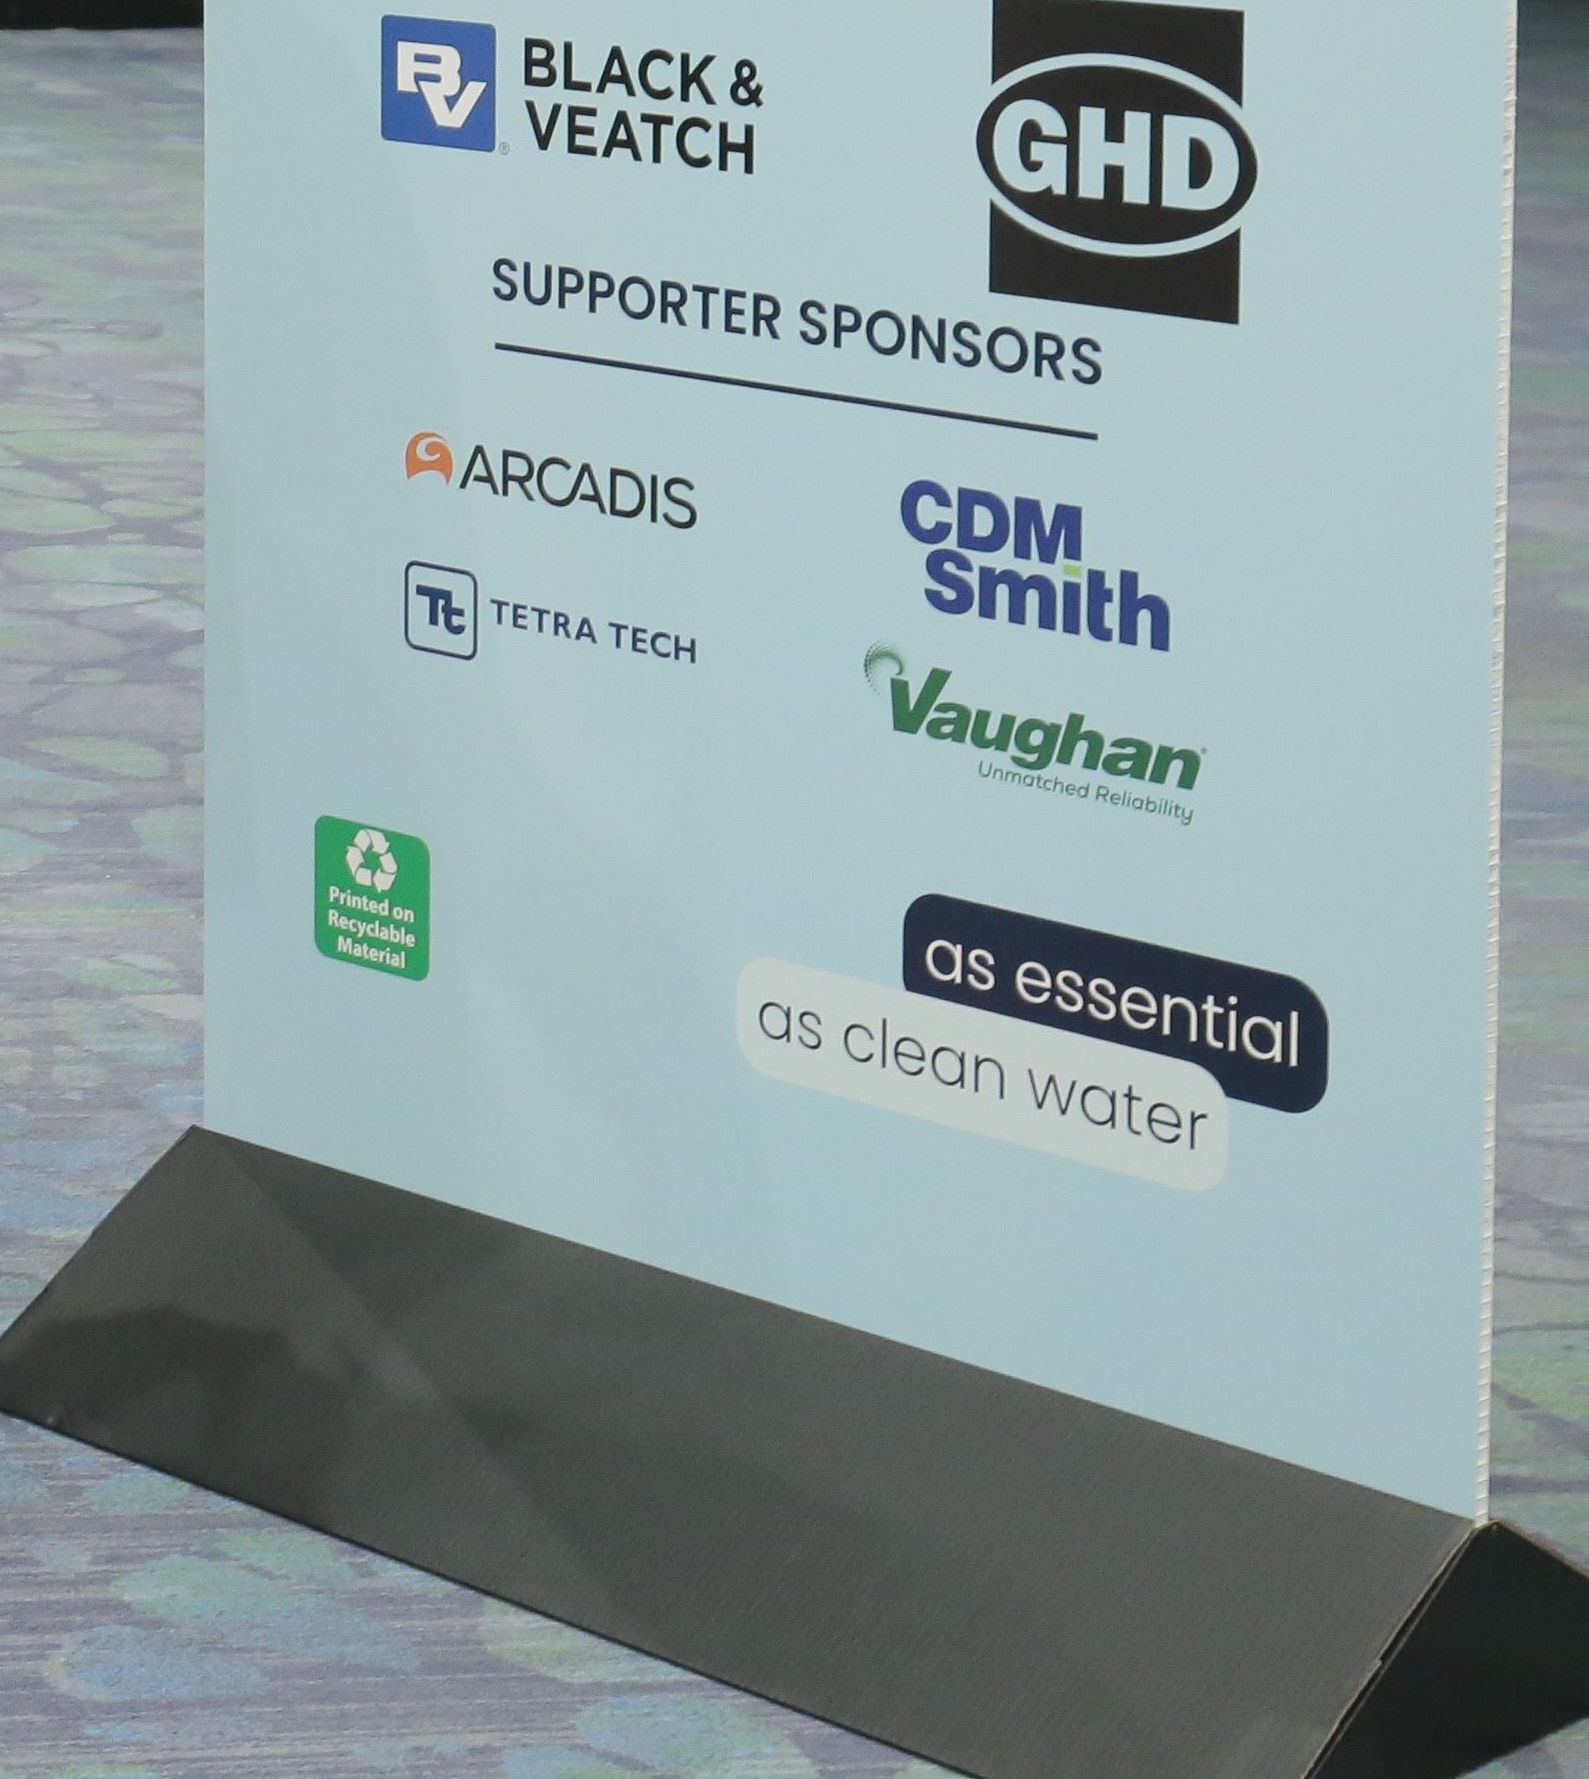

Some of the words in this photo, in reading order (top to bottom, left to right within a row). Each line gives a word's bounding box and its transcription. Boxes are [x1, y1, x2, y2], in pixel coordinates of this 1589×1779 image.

[524, 36, 716, 107] BLACK
[730, 57, 765, 108] &
[524, 99, 755, 176] VEATCH
[992, 97, 1241, 213] GHD
[492, 257, 781, 341] SUPPORTER
[799, 299, 1103, 386] SPONSORS
[459, 443, 698, 531] ARCADIS
[899, 478, 1083, 563] CDM
[490, 598, 597, 646] TETRA
[609, 621, 698, 664] TECH
[922, 549, 1172, 653] Smith
[889, 667, 1203, 792] Vaughan
[977, 759, 1090, 800] Unmatched
[1095, 785, 1194, 826] Reliability
[327, 908, 416, 948] Recyclable
[329, 885, 389, 916] Printed
[392, 905, 415, 923] on
[337, 934, 406, 968] Material
[924, 937, 996, 992] as
[1015, 959, 1299, 1067] essential
[758, 1001, 823, 1051] as
[843, 1017, 1005, 1099] clean
[1027, 1067, 1208, 1150] water
